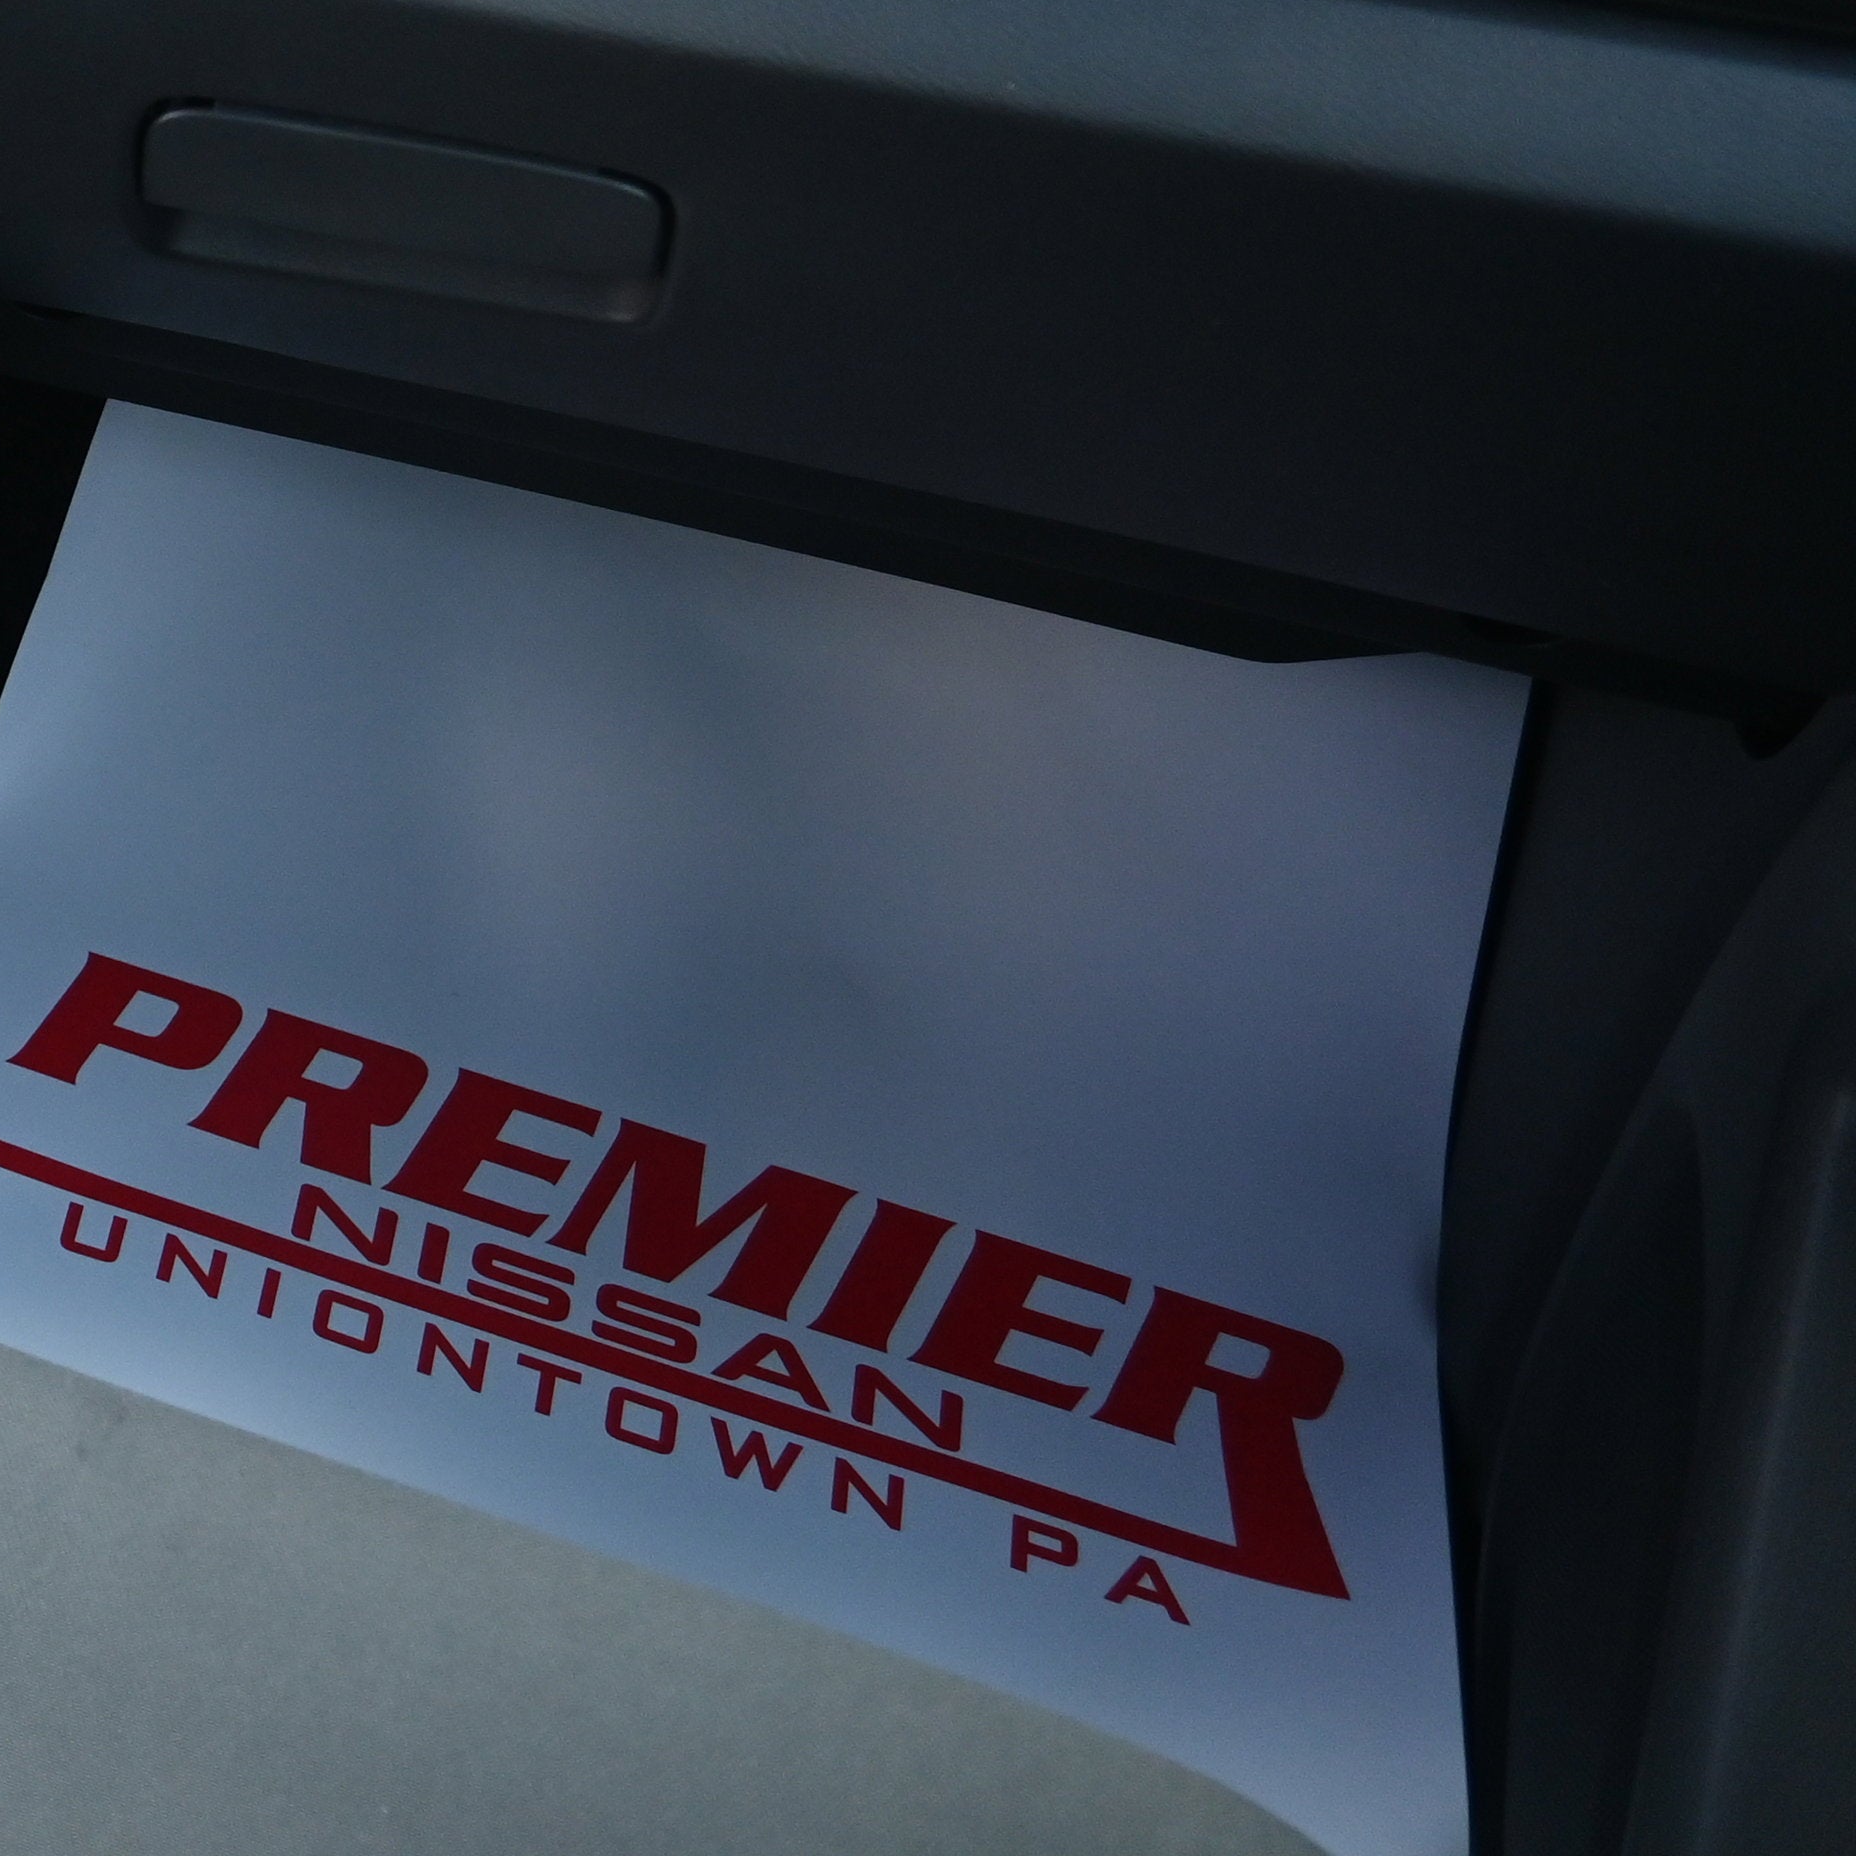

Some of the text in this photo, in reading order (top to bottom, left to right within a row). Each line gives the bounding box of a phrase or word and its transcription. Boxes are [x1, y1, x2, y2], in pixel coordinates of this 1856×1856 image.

[6, 950, 1351, 1601] PREMIER
[58, 1199, 1192, 1628] UNIONTOWN PA
[289, 1182, 965, 1455] NISSAN
